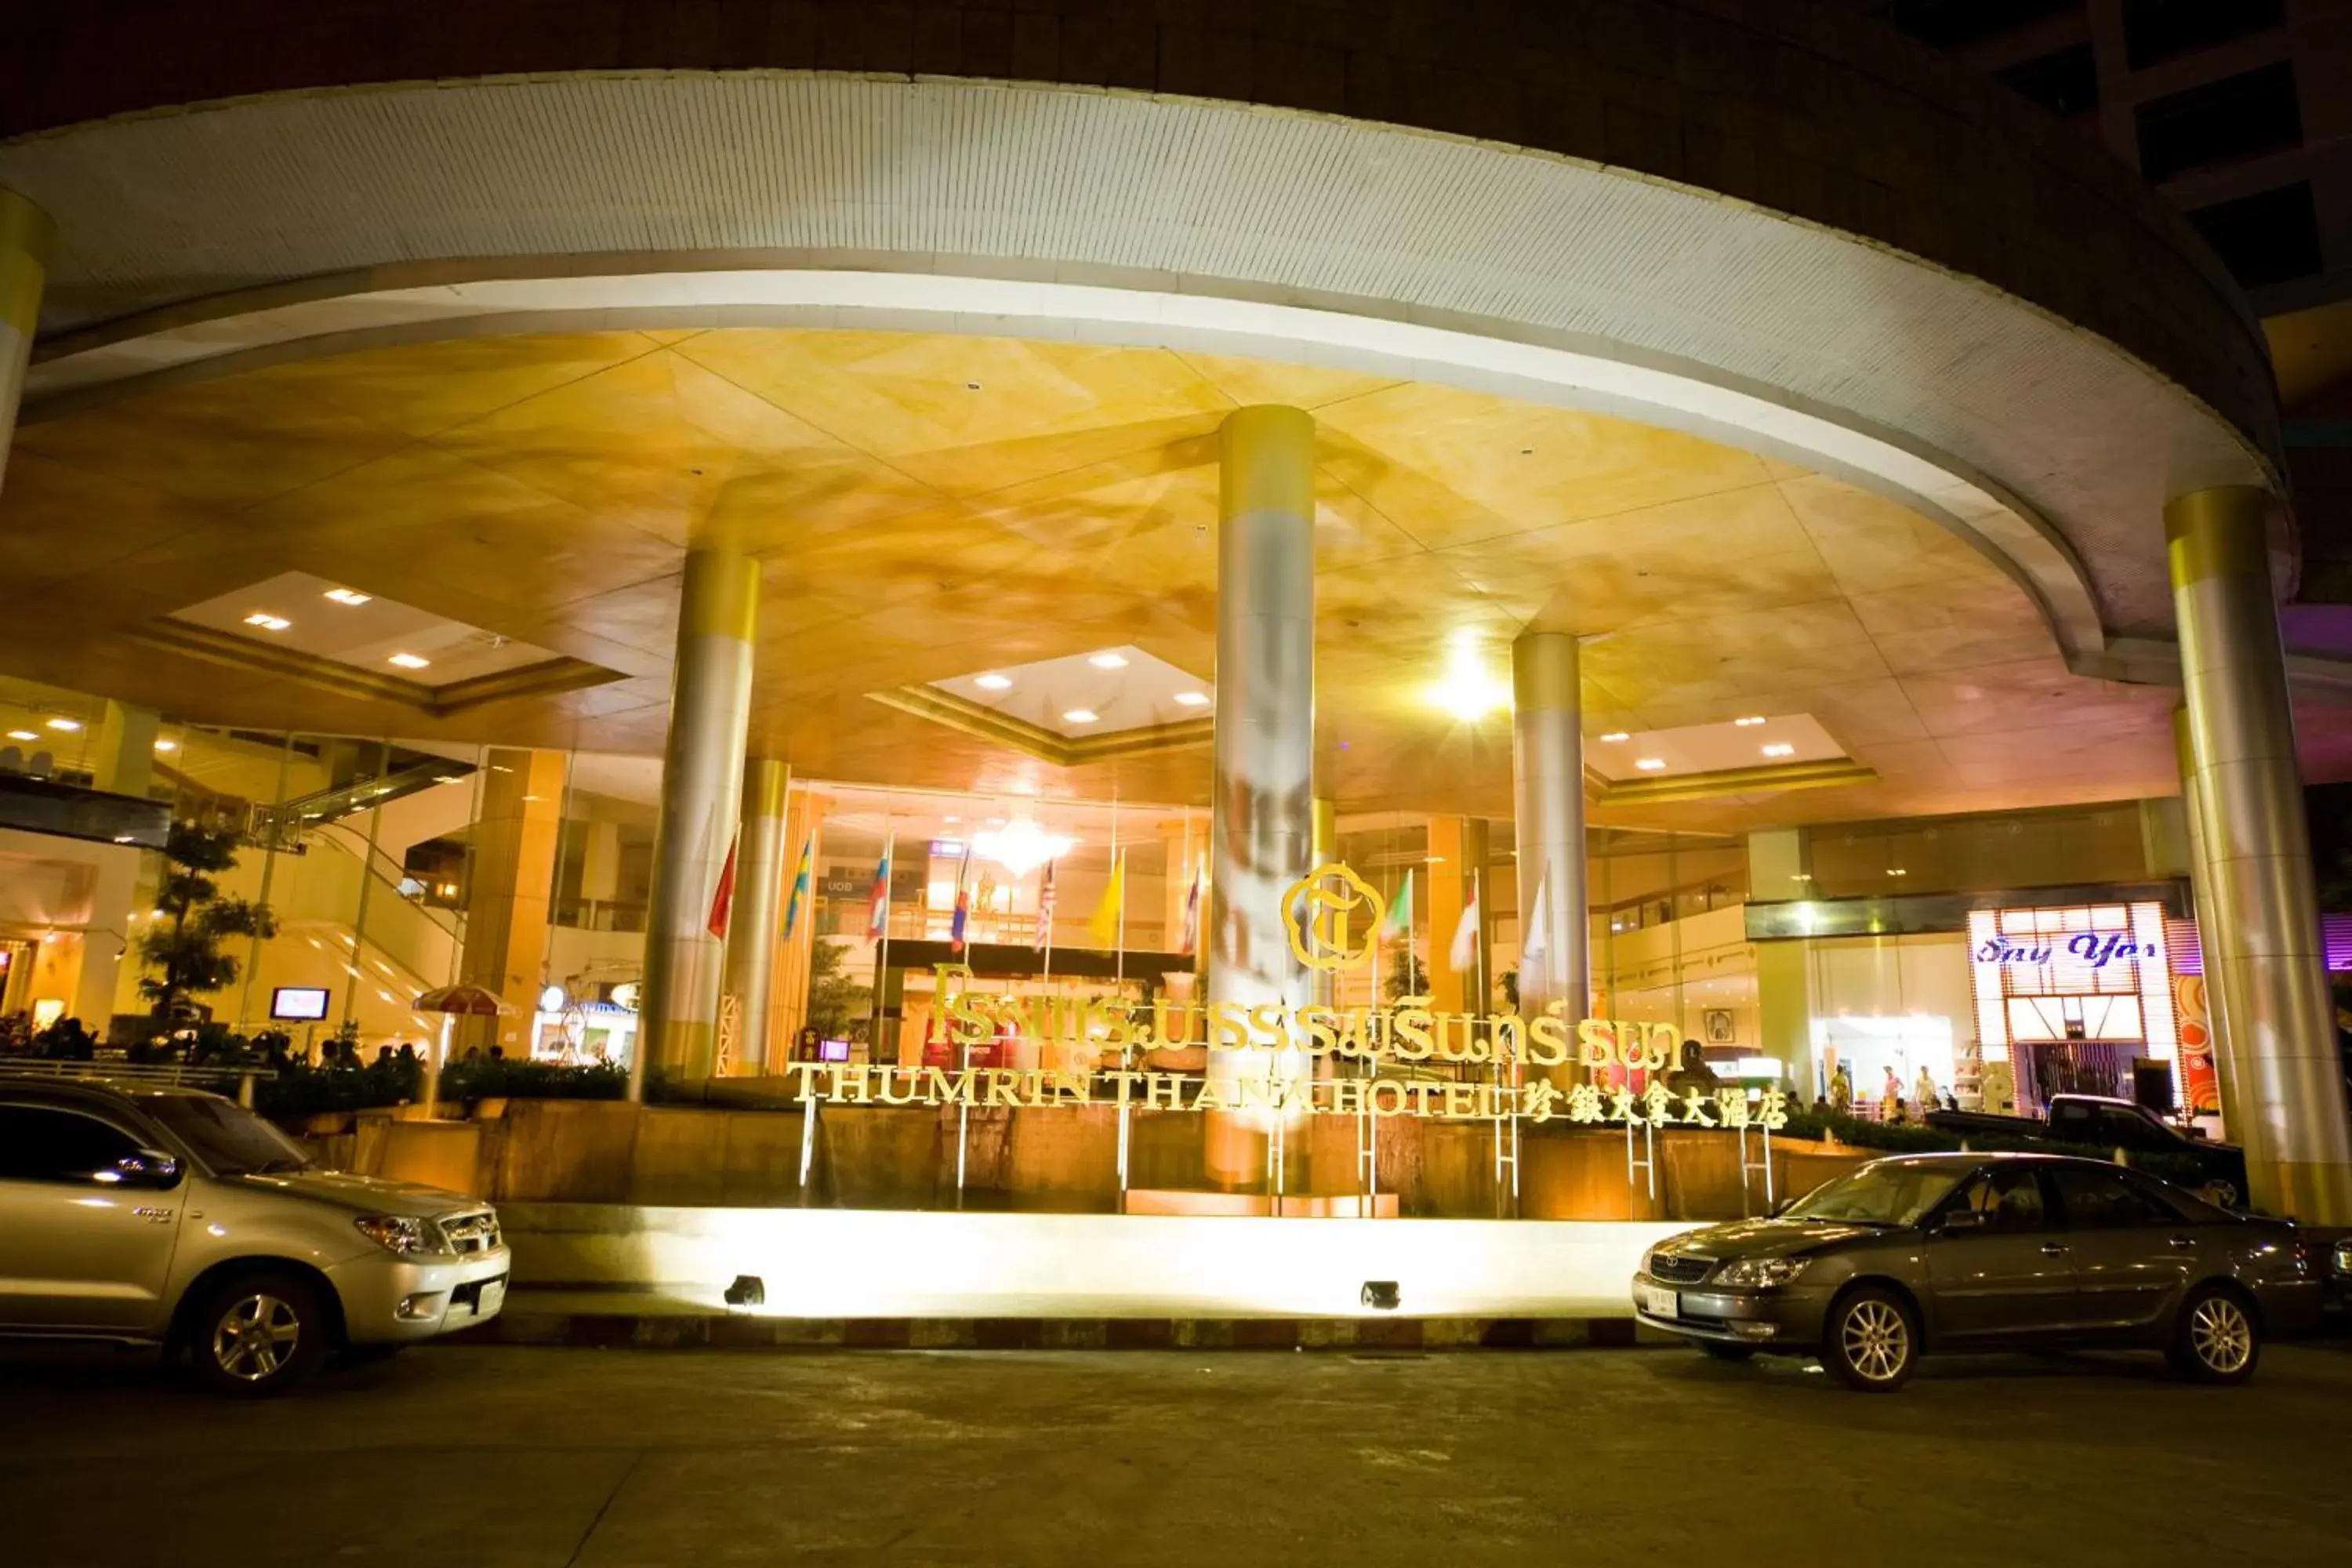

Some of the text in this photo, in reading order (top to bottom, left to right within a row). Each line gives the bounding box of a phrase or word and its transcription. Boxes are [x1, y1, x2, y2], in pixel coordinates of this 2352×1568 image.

[828, 881, 853, 892] UOB
[786, 1061, 1510, 1120] THUMRIN THANA HOTEL
